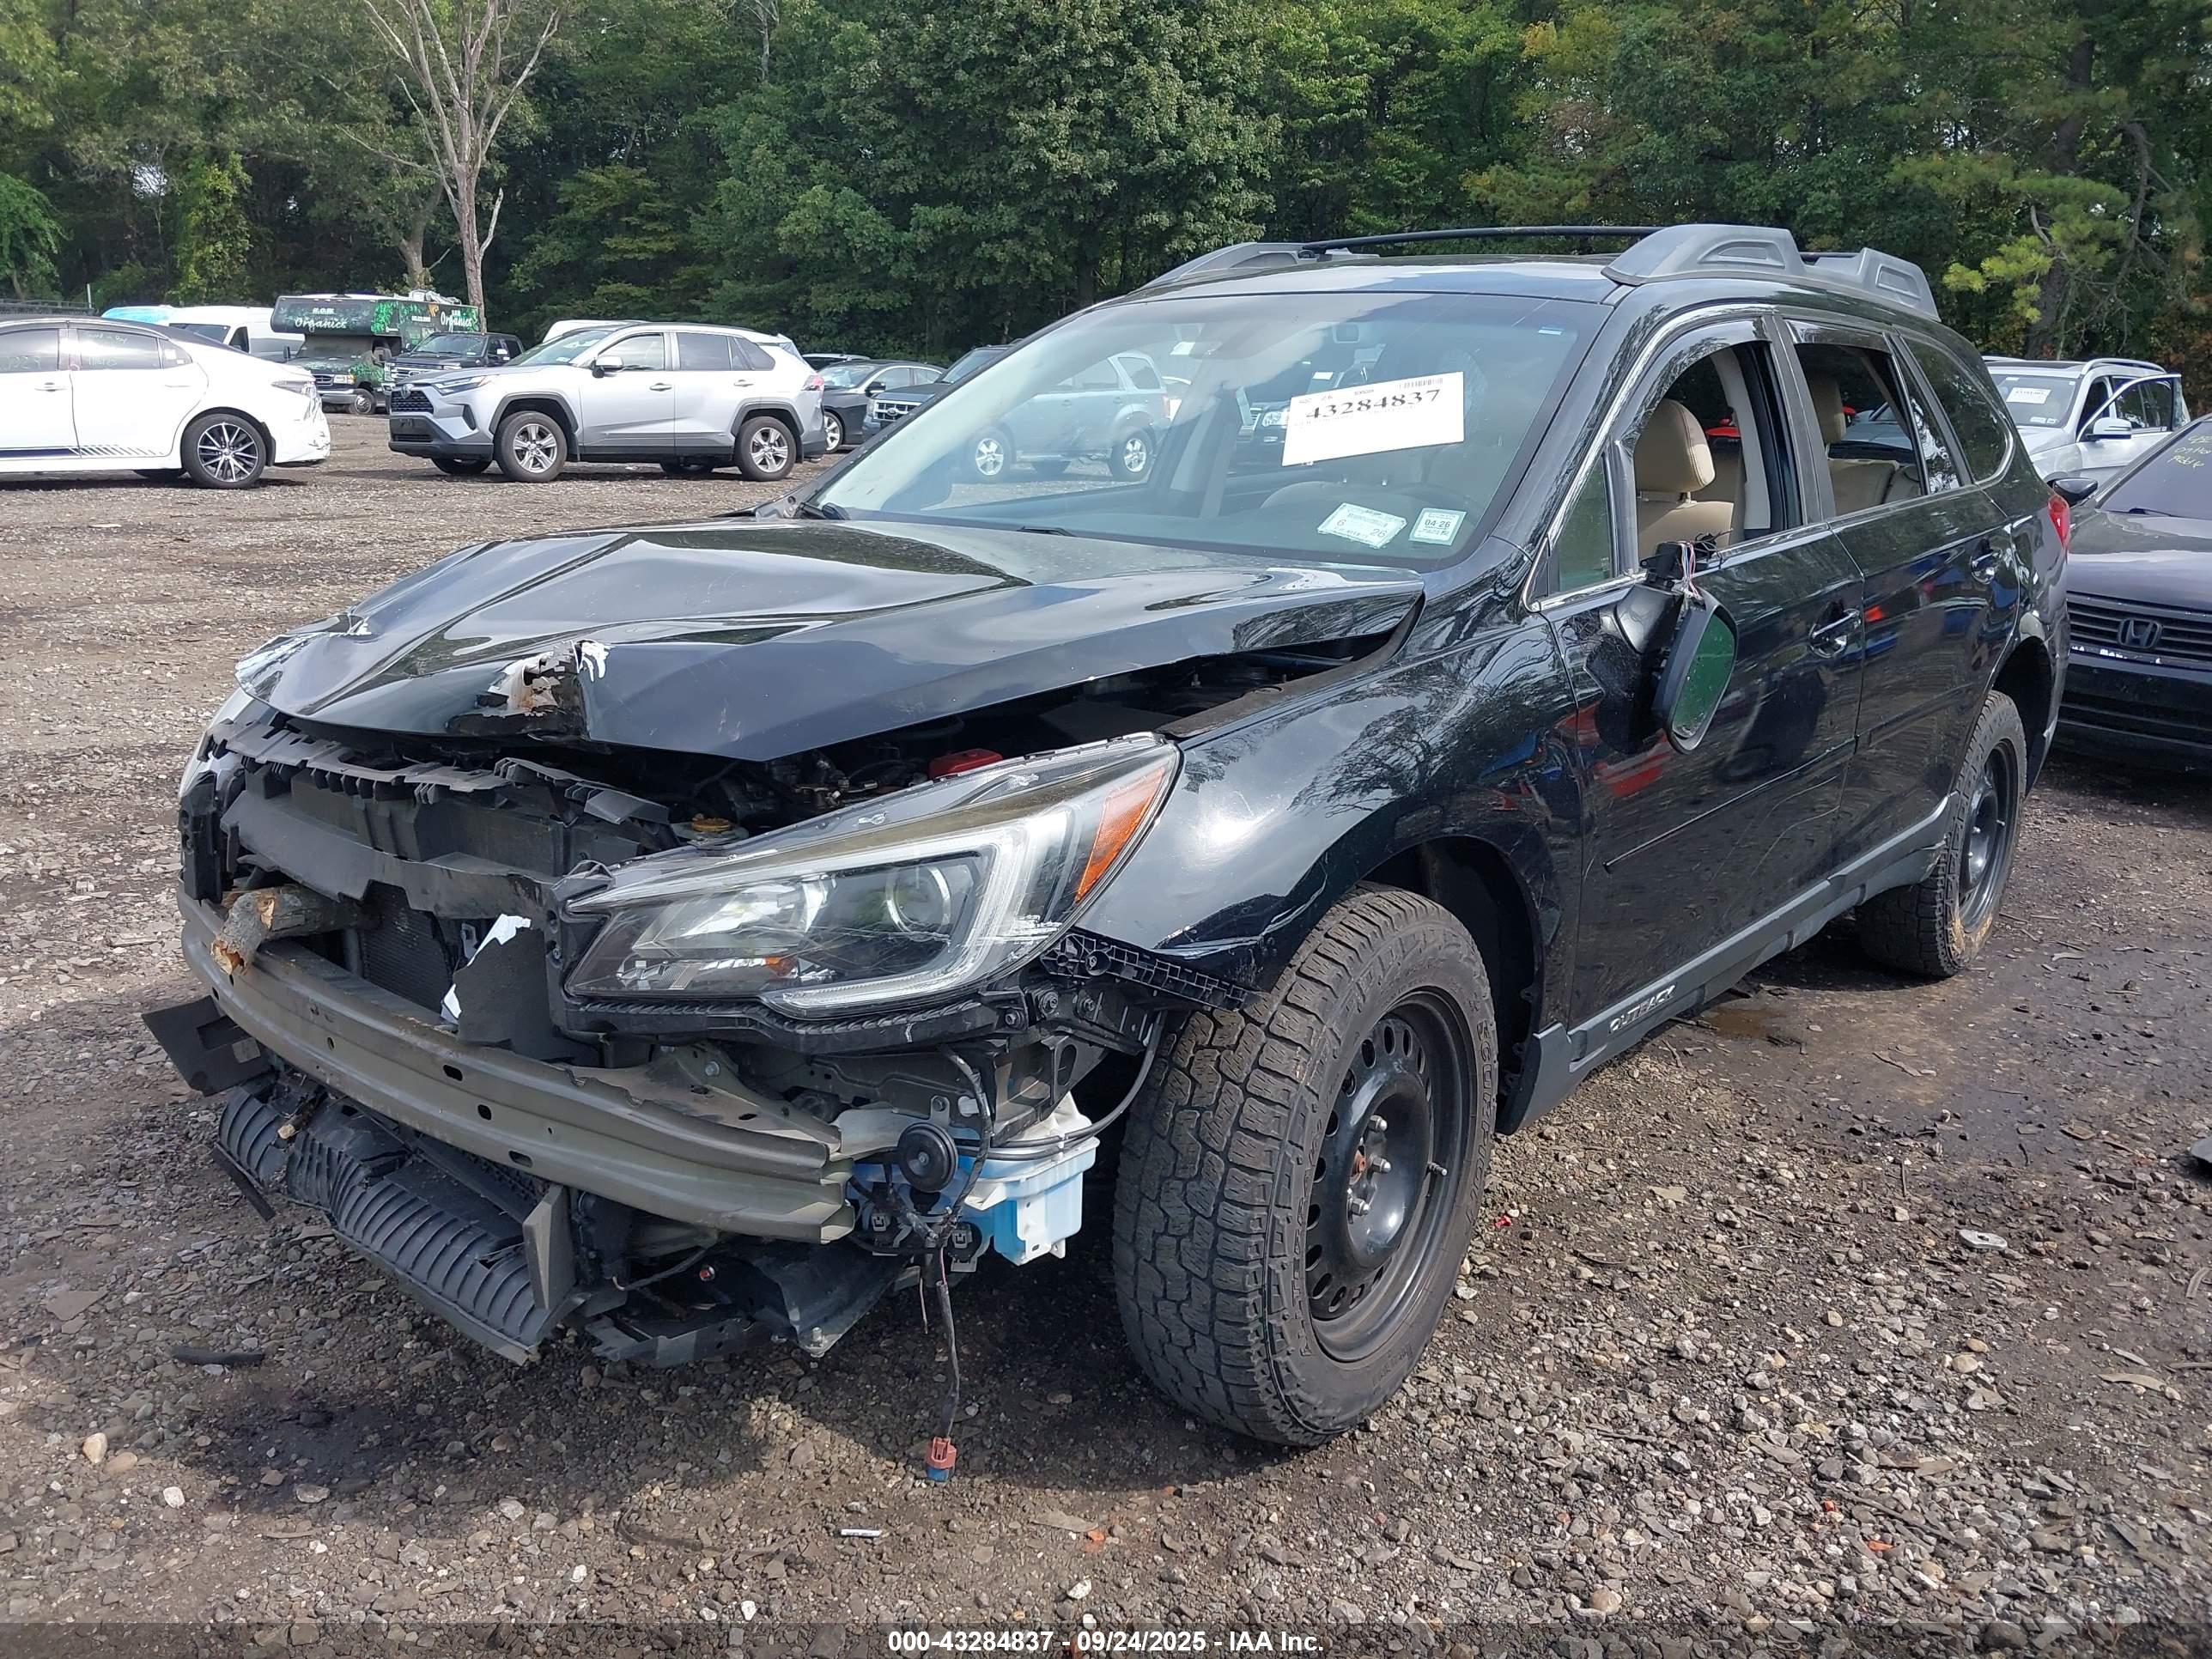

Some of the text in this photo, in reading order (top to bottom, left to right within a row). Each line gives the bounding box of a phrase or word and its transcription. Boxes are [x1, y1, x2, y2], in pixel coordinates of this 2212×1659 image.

[295, 316, 348, 333] Organics
[441, 311, 472, 332] Organics
[1305, 389, 1442, 419] 43284837
